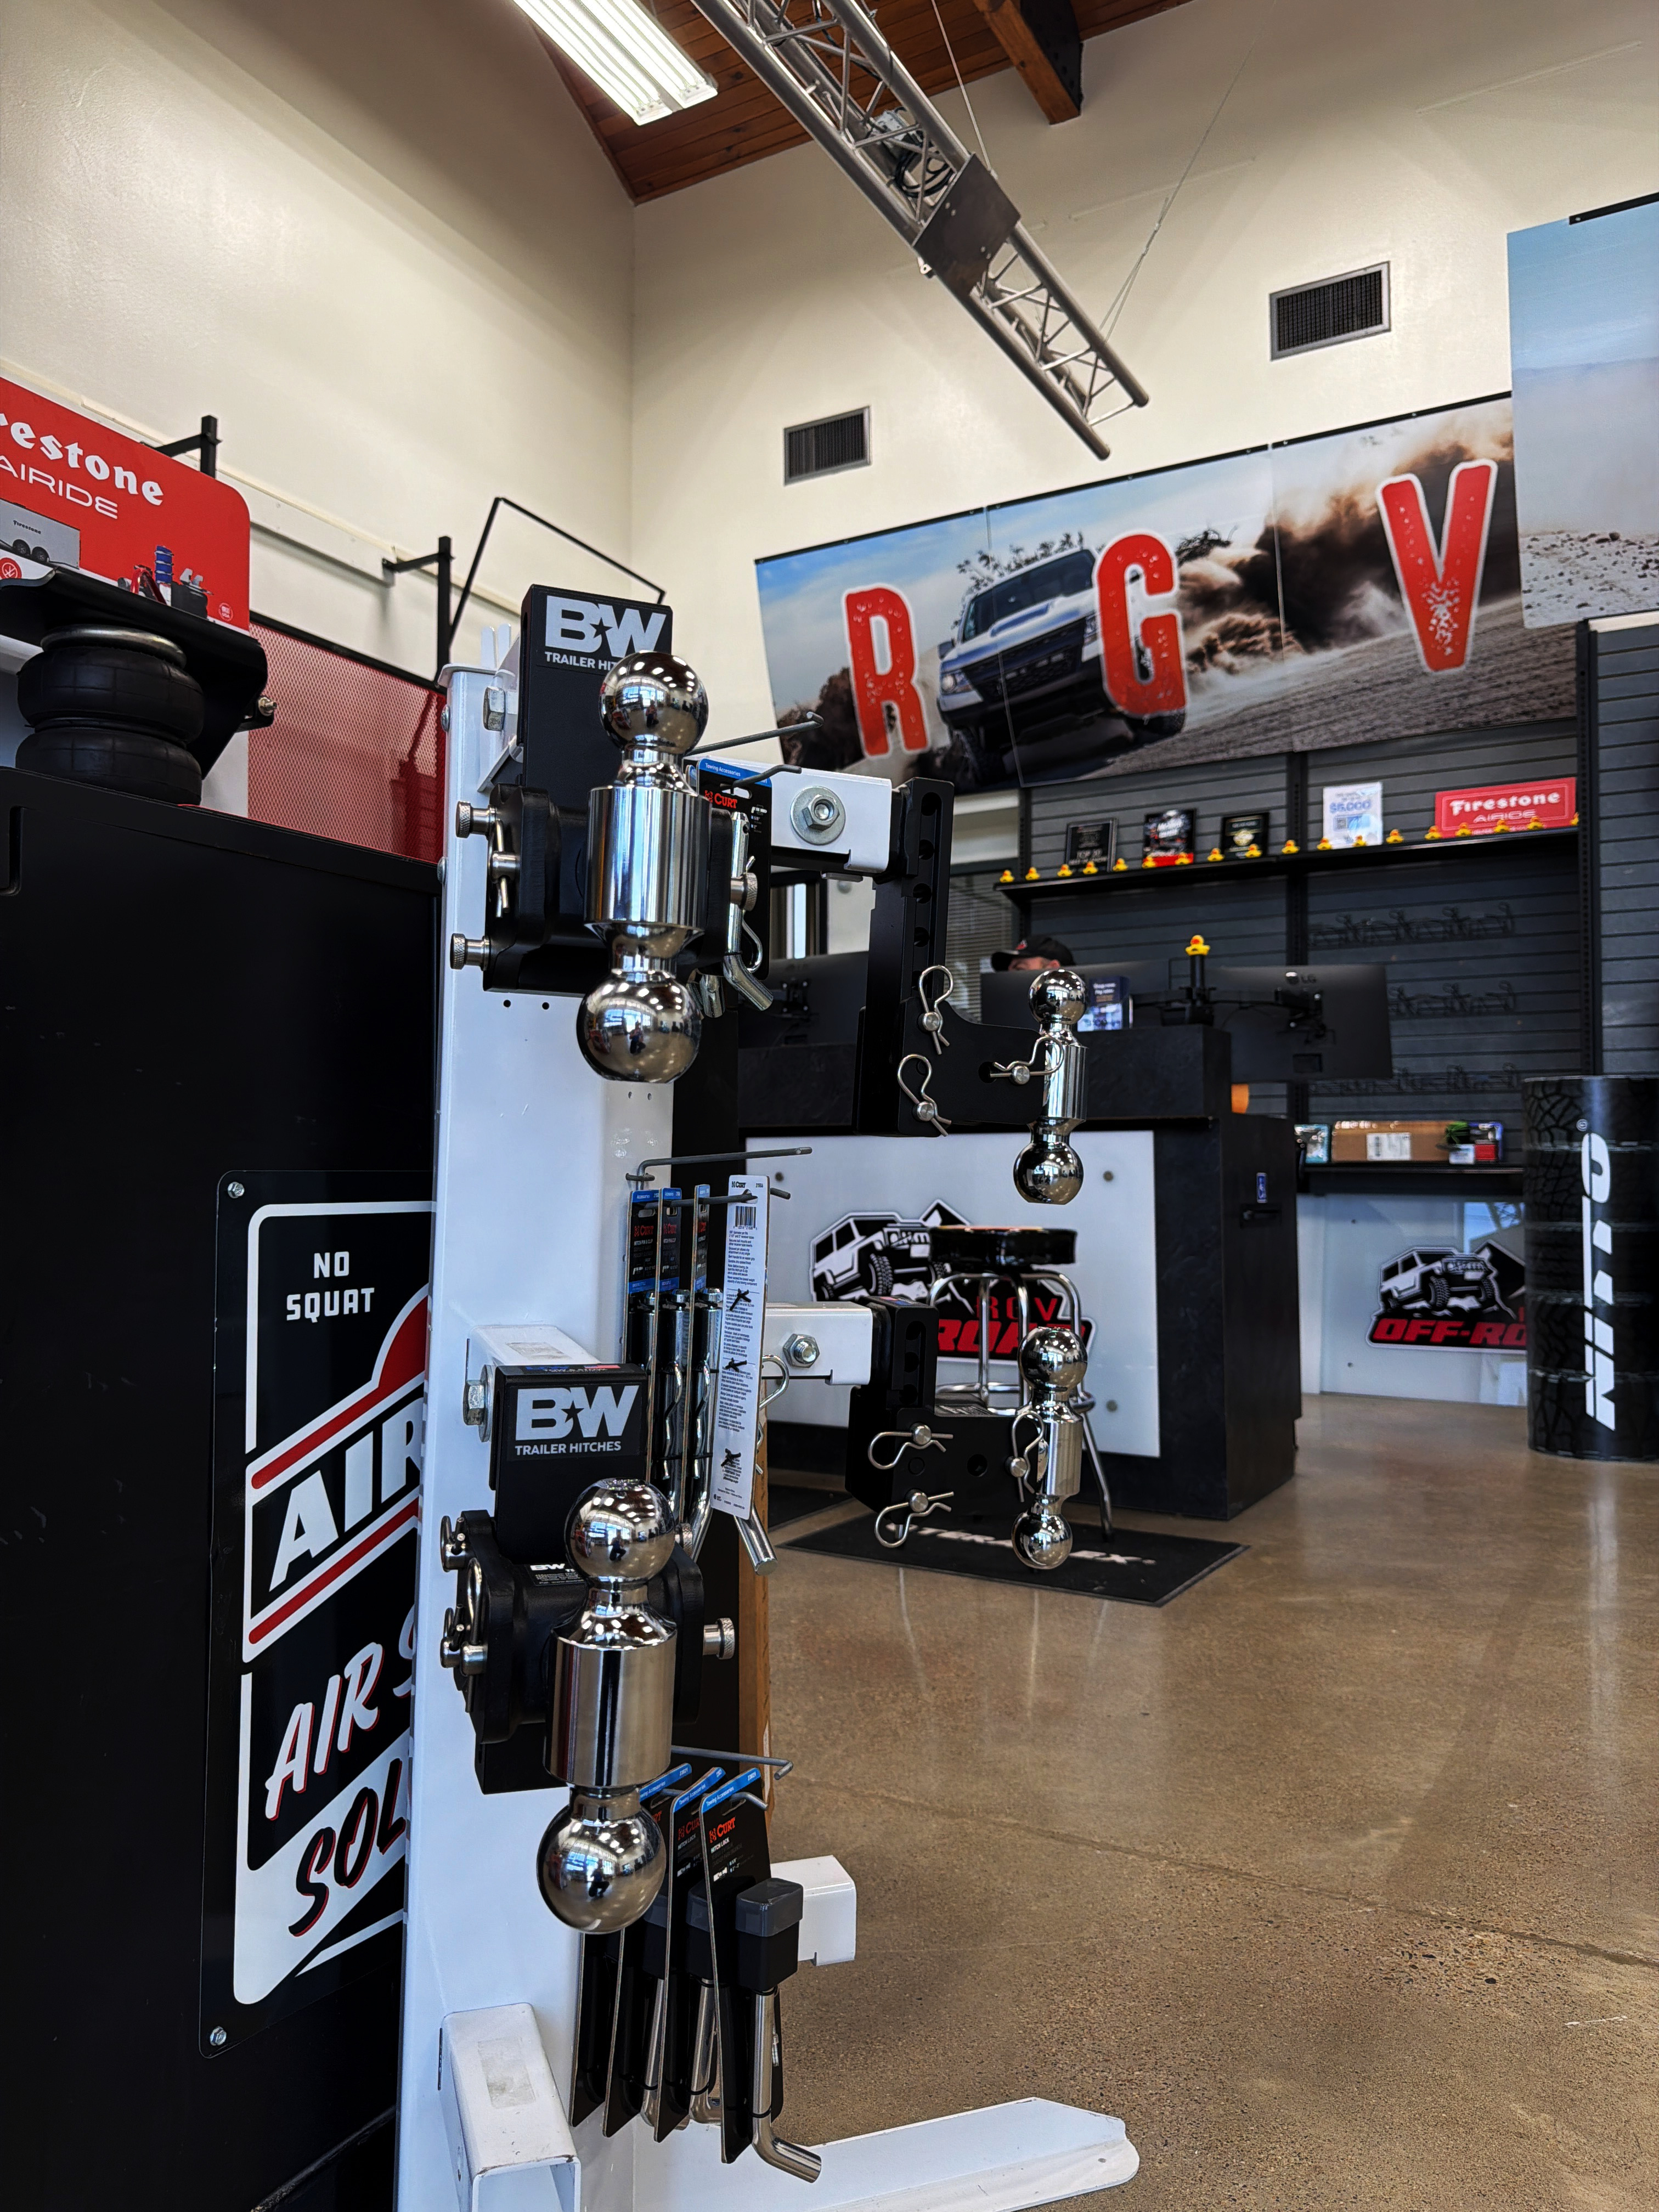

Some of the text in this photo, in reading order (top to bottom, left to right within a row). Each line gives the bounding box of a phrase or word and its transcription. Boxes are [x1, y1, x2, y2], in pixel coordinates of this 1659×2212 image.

[13, 520, 42, 535] Firestone
[544, 651, 596, 669] TRAILER
[705, 763, 741, 777] Towing Accessories
[714, 793, 738, 809] CURT
[1449, 792, 1561, 816] Firestone
[1473, 809, 1537, 823] AIRIDE
[640, 1225, 654, 1235] CURT
[313, 1251, 349, 1279] NO
[286, 1287, 375, 1323] SQUAT
[515, 1441, 622, 1456] TRAILER HITCHES
[269, 1397, 424, 1592] AIR
[264, 1642, 384, 1821] AIR
[706, 1796, 717, 1807] Towing
[716, 1786, 734, 1801] Accessories
[716, 1816, 736, 1837] CURT
